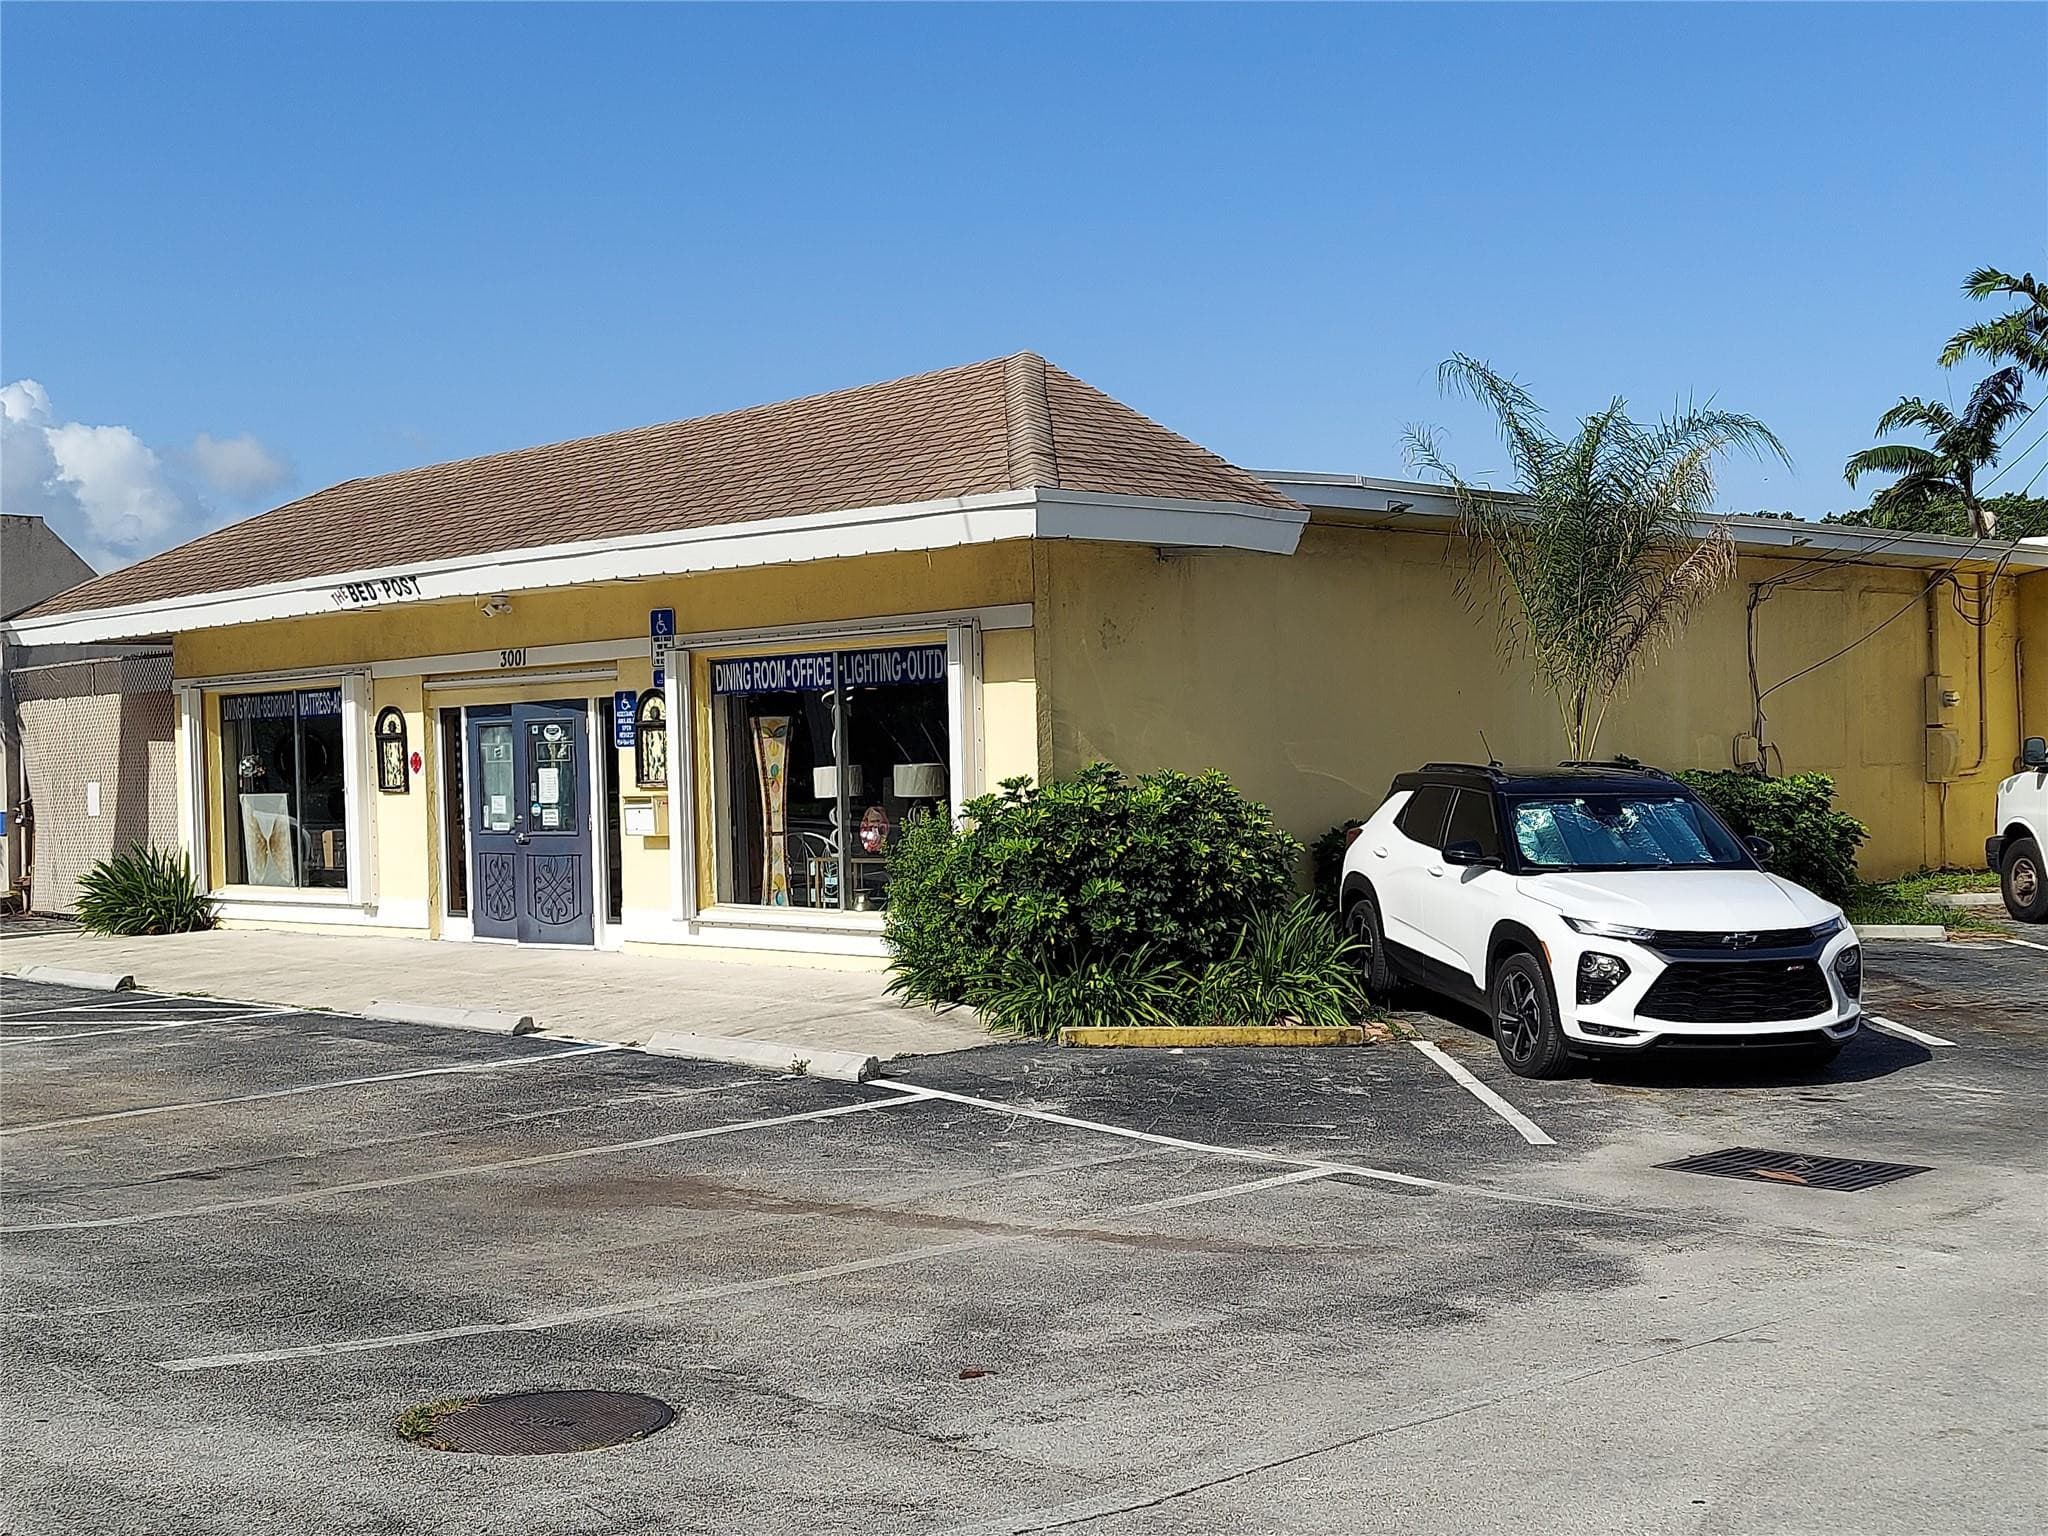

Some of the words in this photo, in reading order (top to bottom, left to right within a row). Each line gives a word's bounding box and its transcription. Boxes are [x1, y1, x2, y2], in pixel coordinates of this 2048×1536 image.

[331, 587, 348, 606] THE
[345, 583, 378, 602] BED
[380, 576, 421, 599] POST
[500, 648, 527, 667] 3001
[715, 662, 750, 692] DINING
